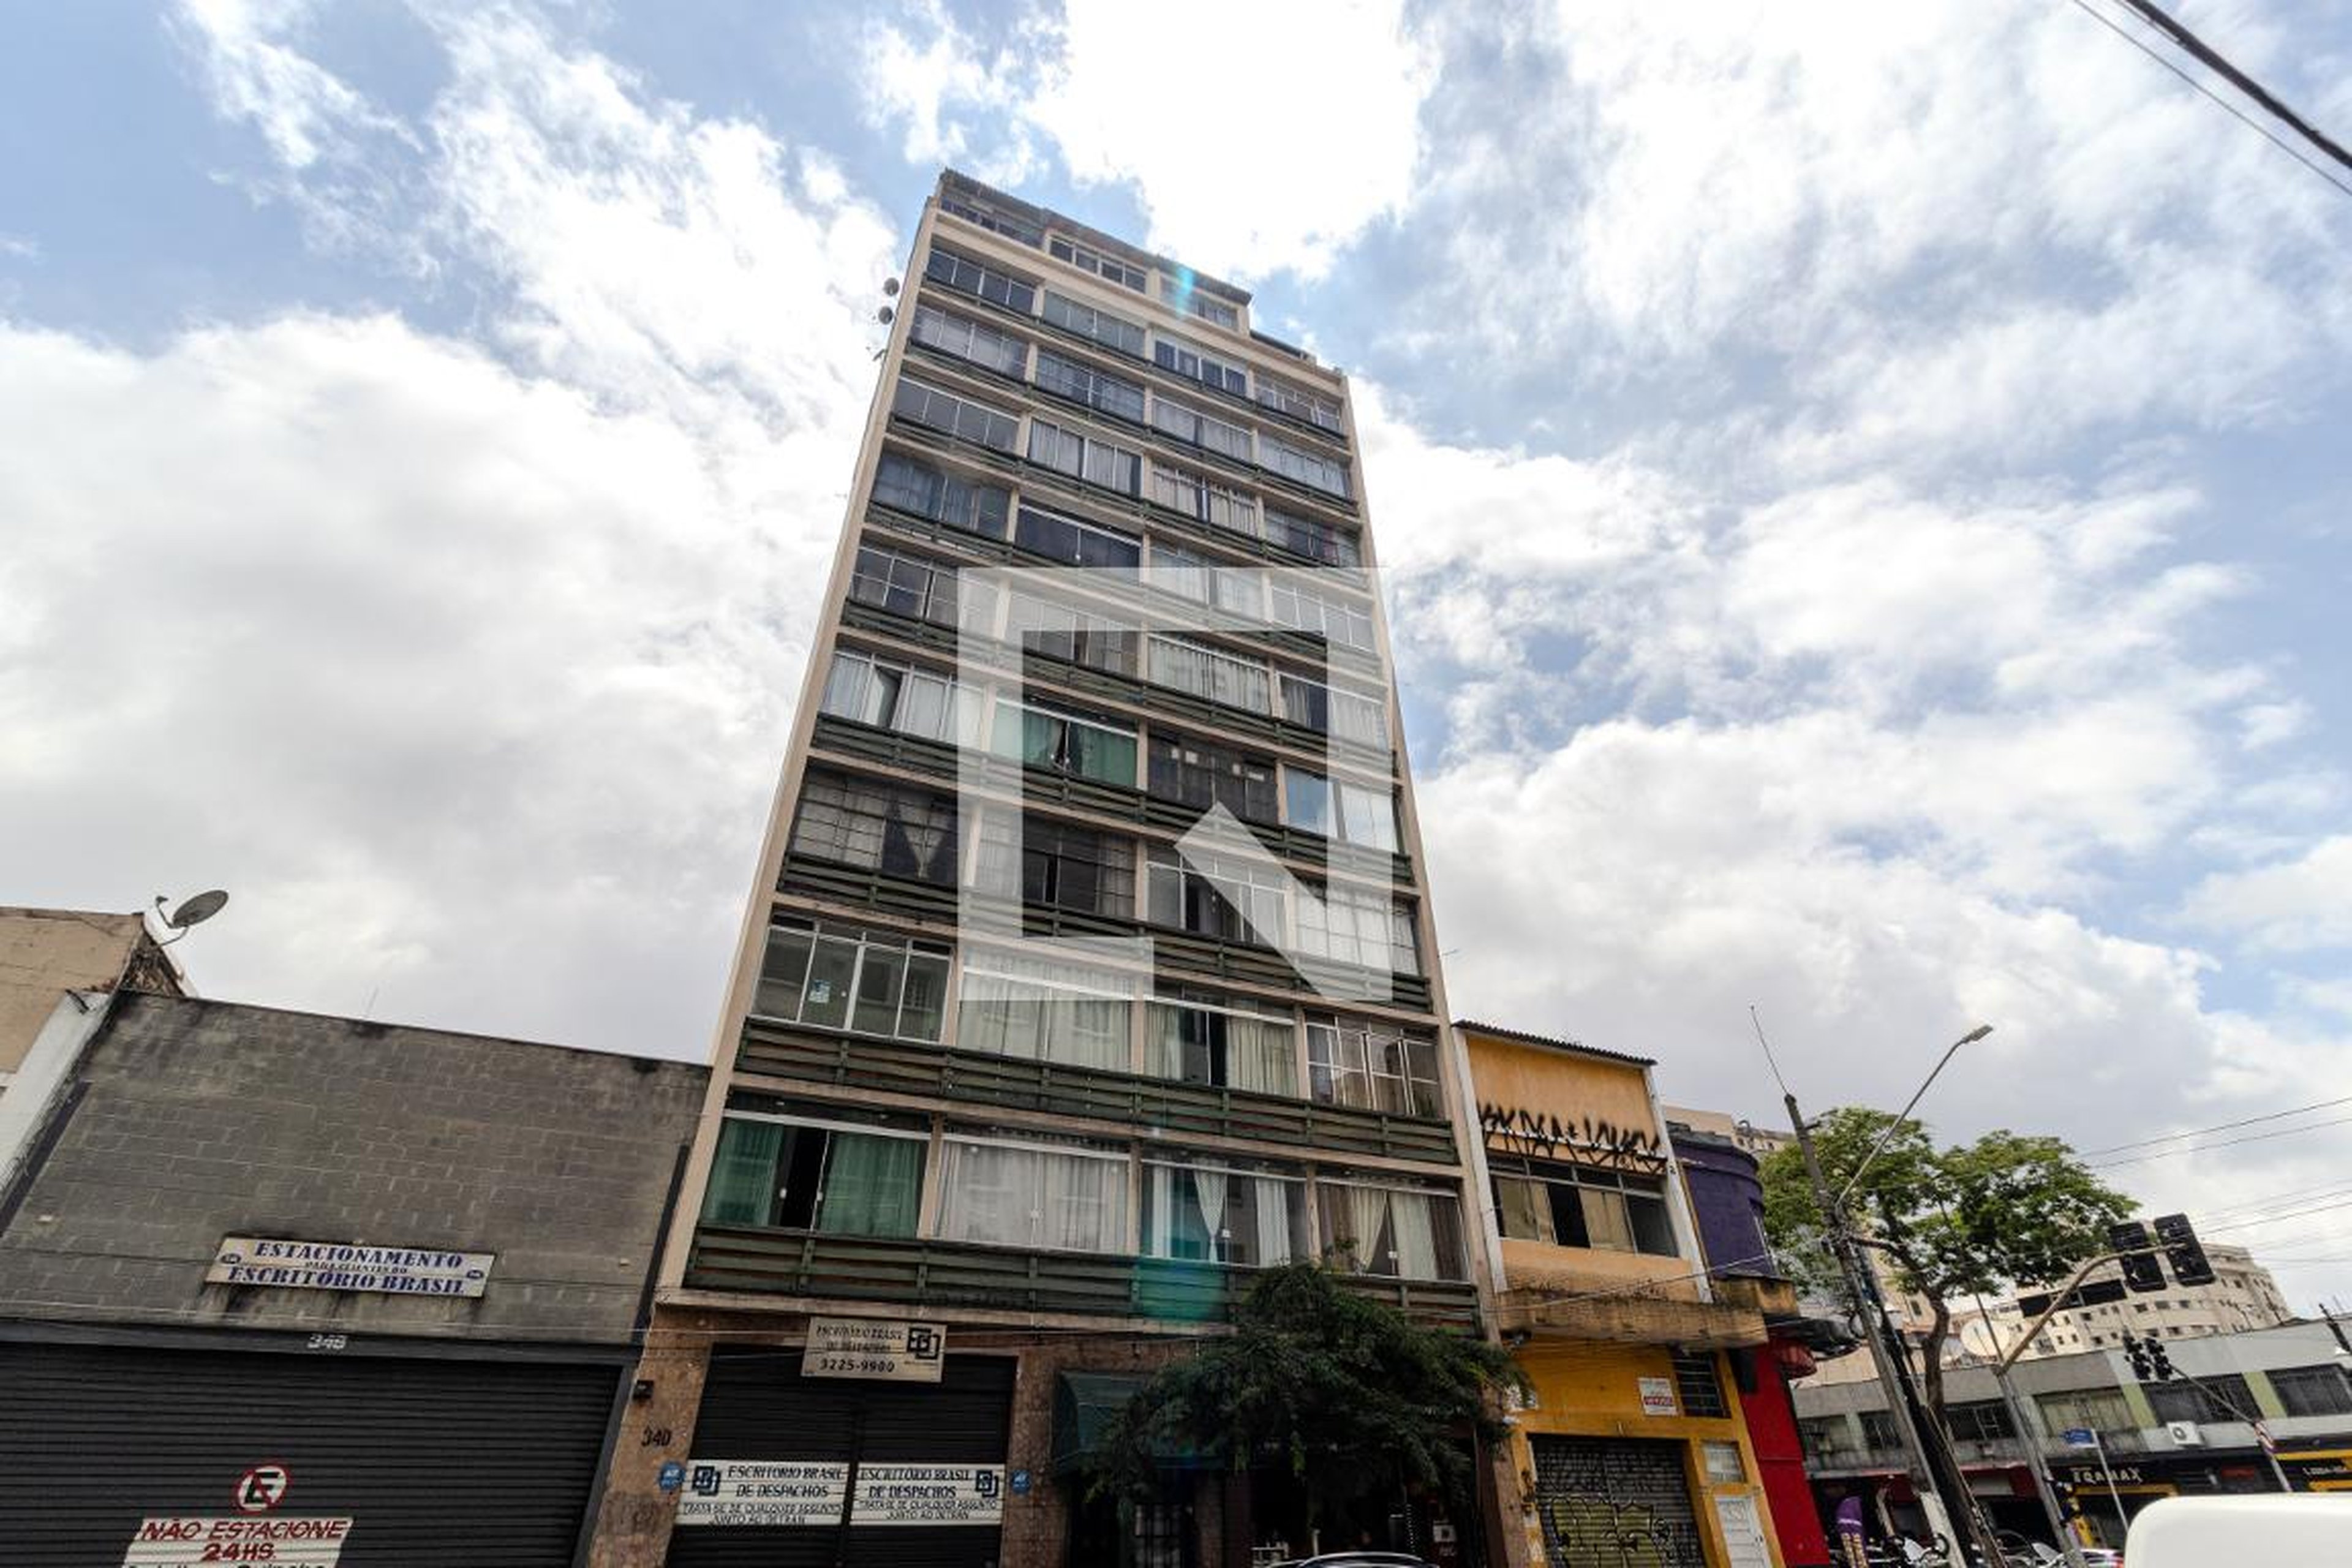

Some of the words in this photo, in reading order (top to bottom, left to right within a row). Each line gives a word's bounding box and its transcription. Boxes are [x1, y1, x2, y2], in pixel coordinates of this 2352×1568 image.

[254, 1242, 463, 1268] ESTACIONAMENTO
[380, 1274, 464, 1294] BRASIL
[802, 1467, 845, 1480] BRASIL
[935, 1469, 970, 1480] BRASIL
[735, 1483, 753, 1498] DE
[756, 1483, 830, 1498] DESPACHOS
[869, 1485, 882, 1498] DE
[889, 1485, 957, 1498] DESPACHOS
[141, 1519, 202, 1540] NÃO
[208, 1520, 350, 1540] ESTACIONE
